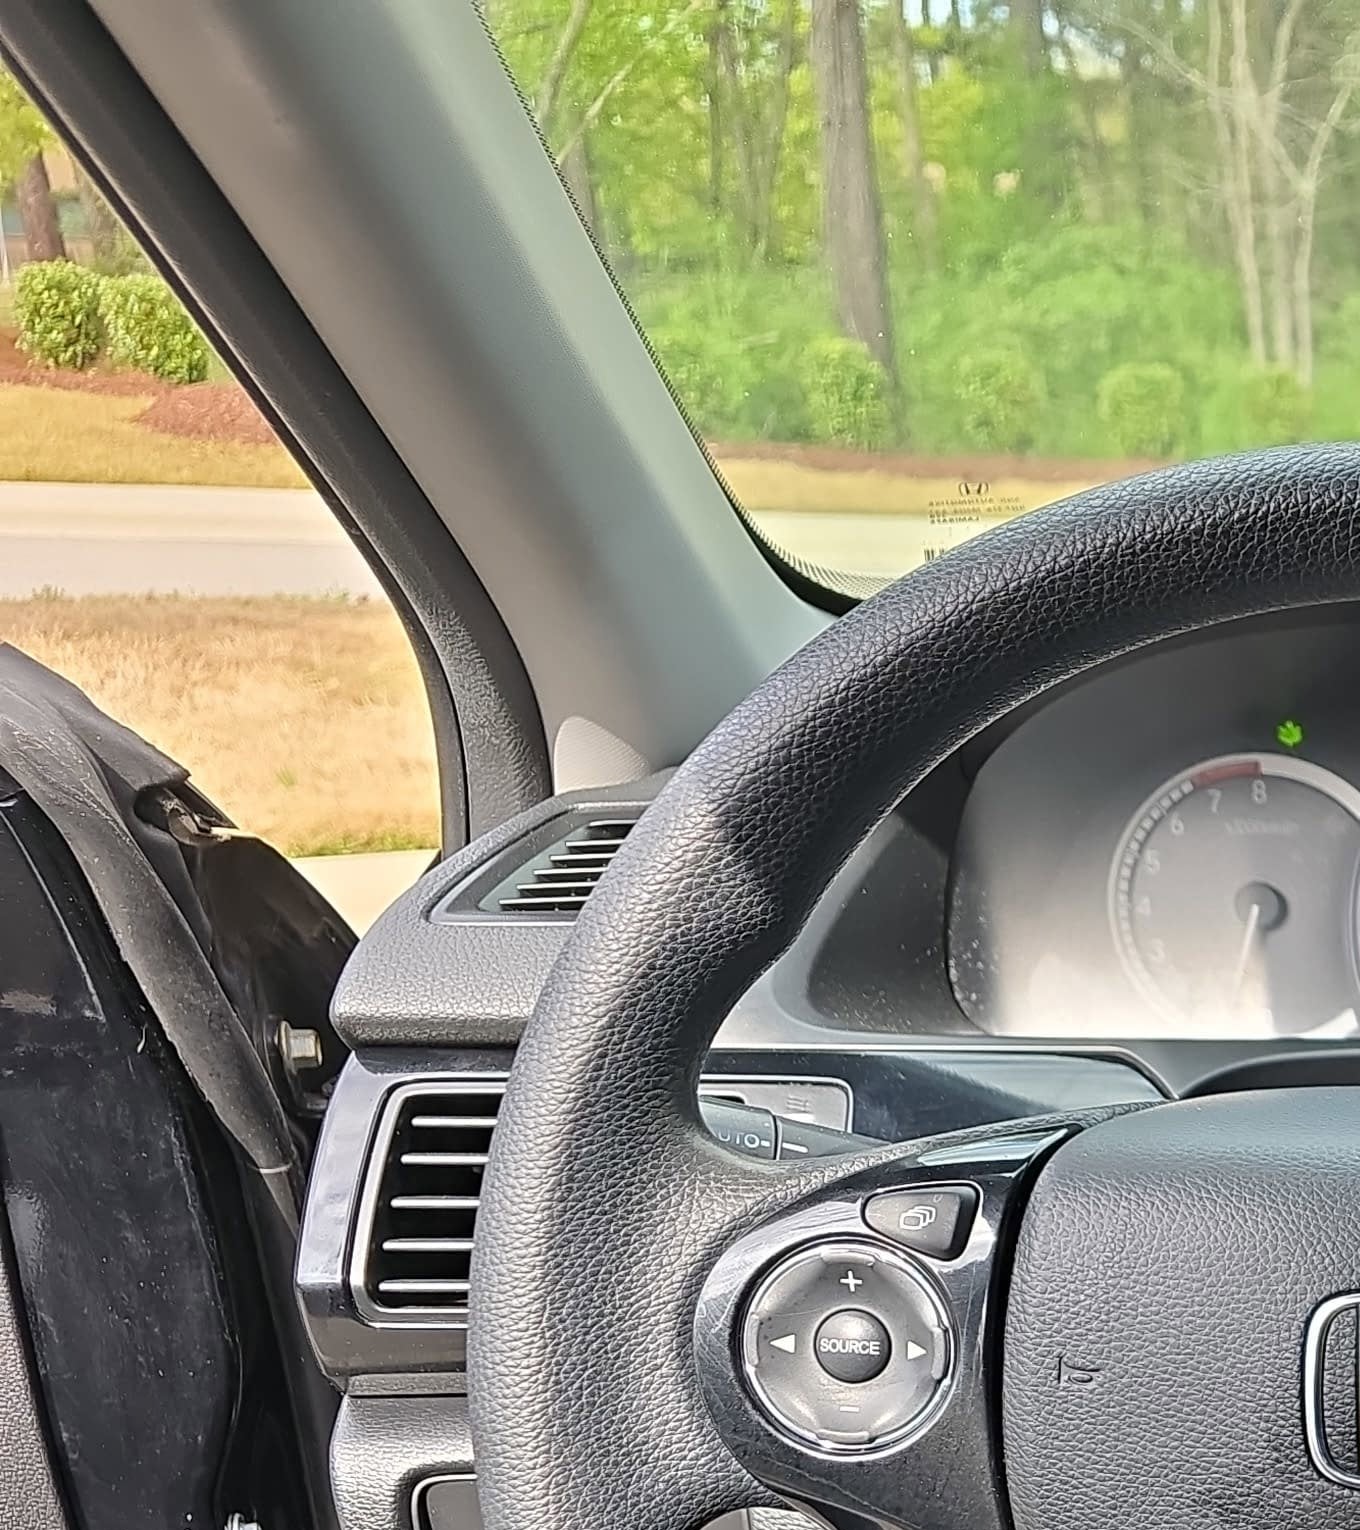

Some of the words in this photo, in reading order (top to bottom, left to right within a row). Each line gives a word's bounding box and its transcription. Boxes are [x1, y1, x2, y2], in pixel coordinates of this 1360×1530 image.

[1207, 789, 1222, 814] 7
[1251, 780, 1268, 804] 8
[1170, 812, 1184, 835] 6
[718, 1127, 761, 1149] UTO
[819, 1337, 881, 1356] SOURCE
